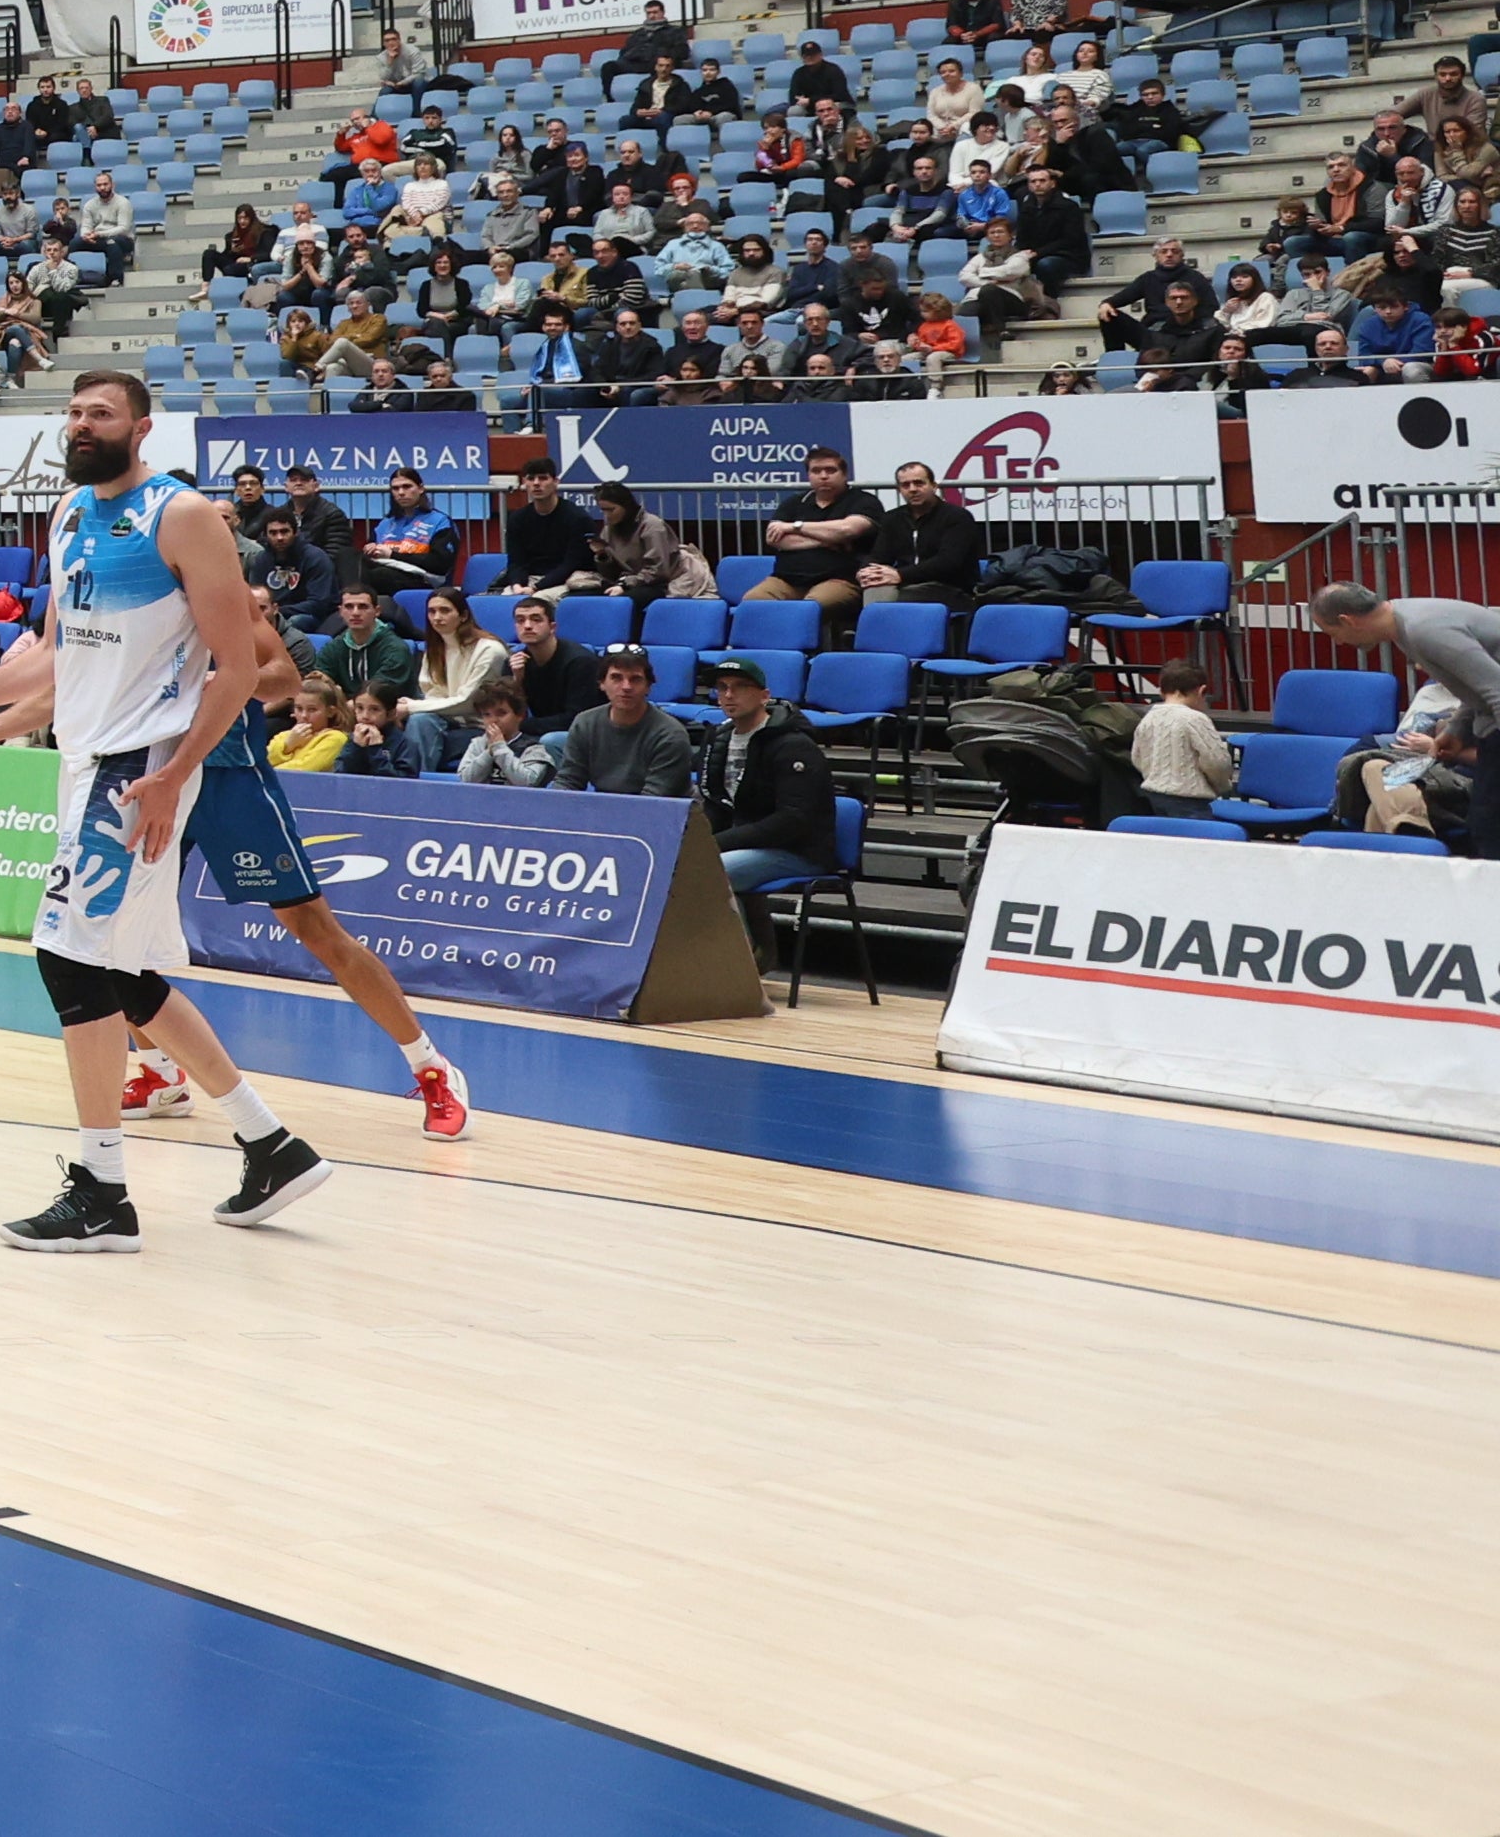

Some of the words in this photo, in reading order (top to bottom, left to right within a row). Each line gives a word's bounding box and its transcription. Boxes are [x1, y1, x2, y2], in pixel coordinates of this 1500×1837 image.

[221, 5, 265, 17] GIPUZKOA
[516, 5, 643, 30] www.montai.e
[710, 417, 770, 436] AUPA
[255, 445, 482, 470] ZUAZNABAR
[710, 443, 821, 465] GIPUZKOA
[67, 570, 94, 611] 12
[405, 840, 620, 897] GANBOA
[397, 882, 491, 911] Centro
[505, 894, 613, 923] Gráfico
[990, 901, 1075, 961] EL
[1091, 911, 1368, 991] DIARIO
